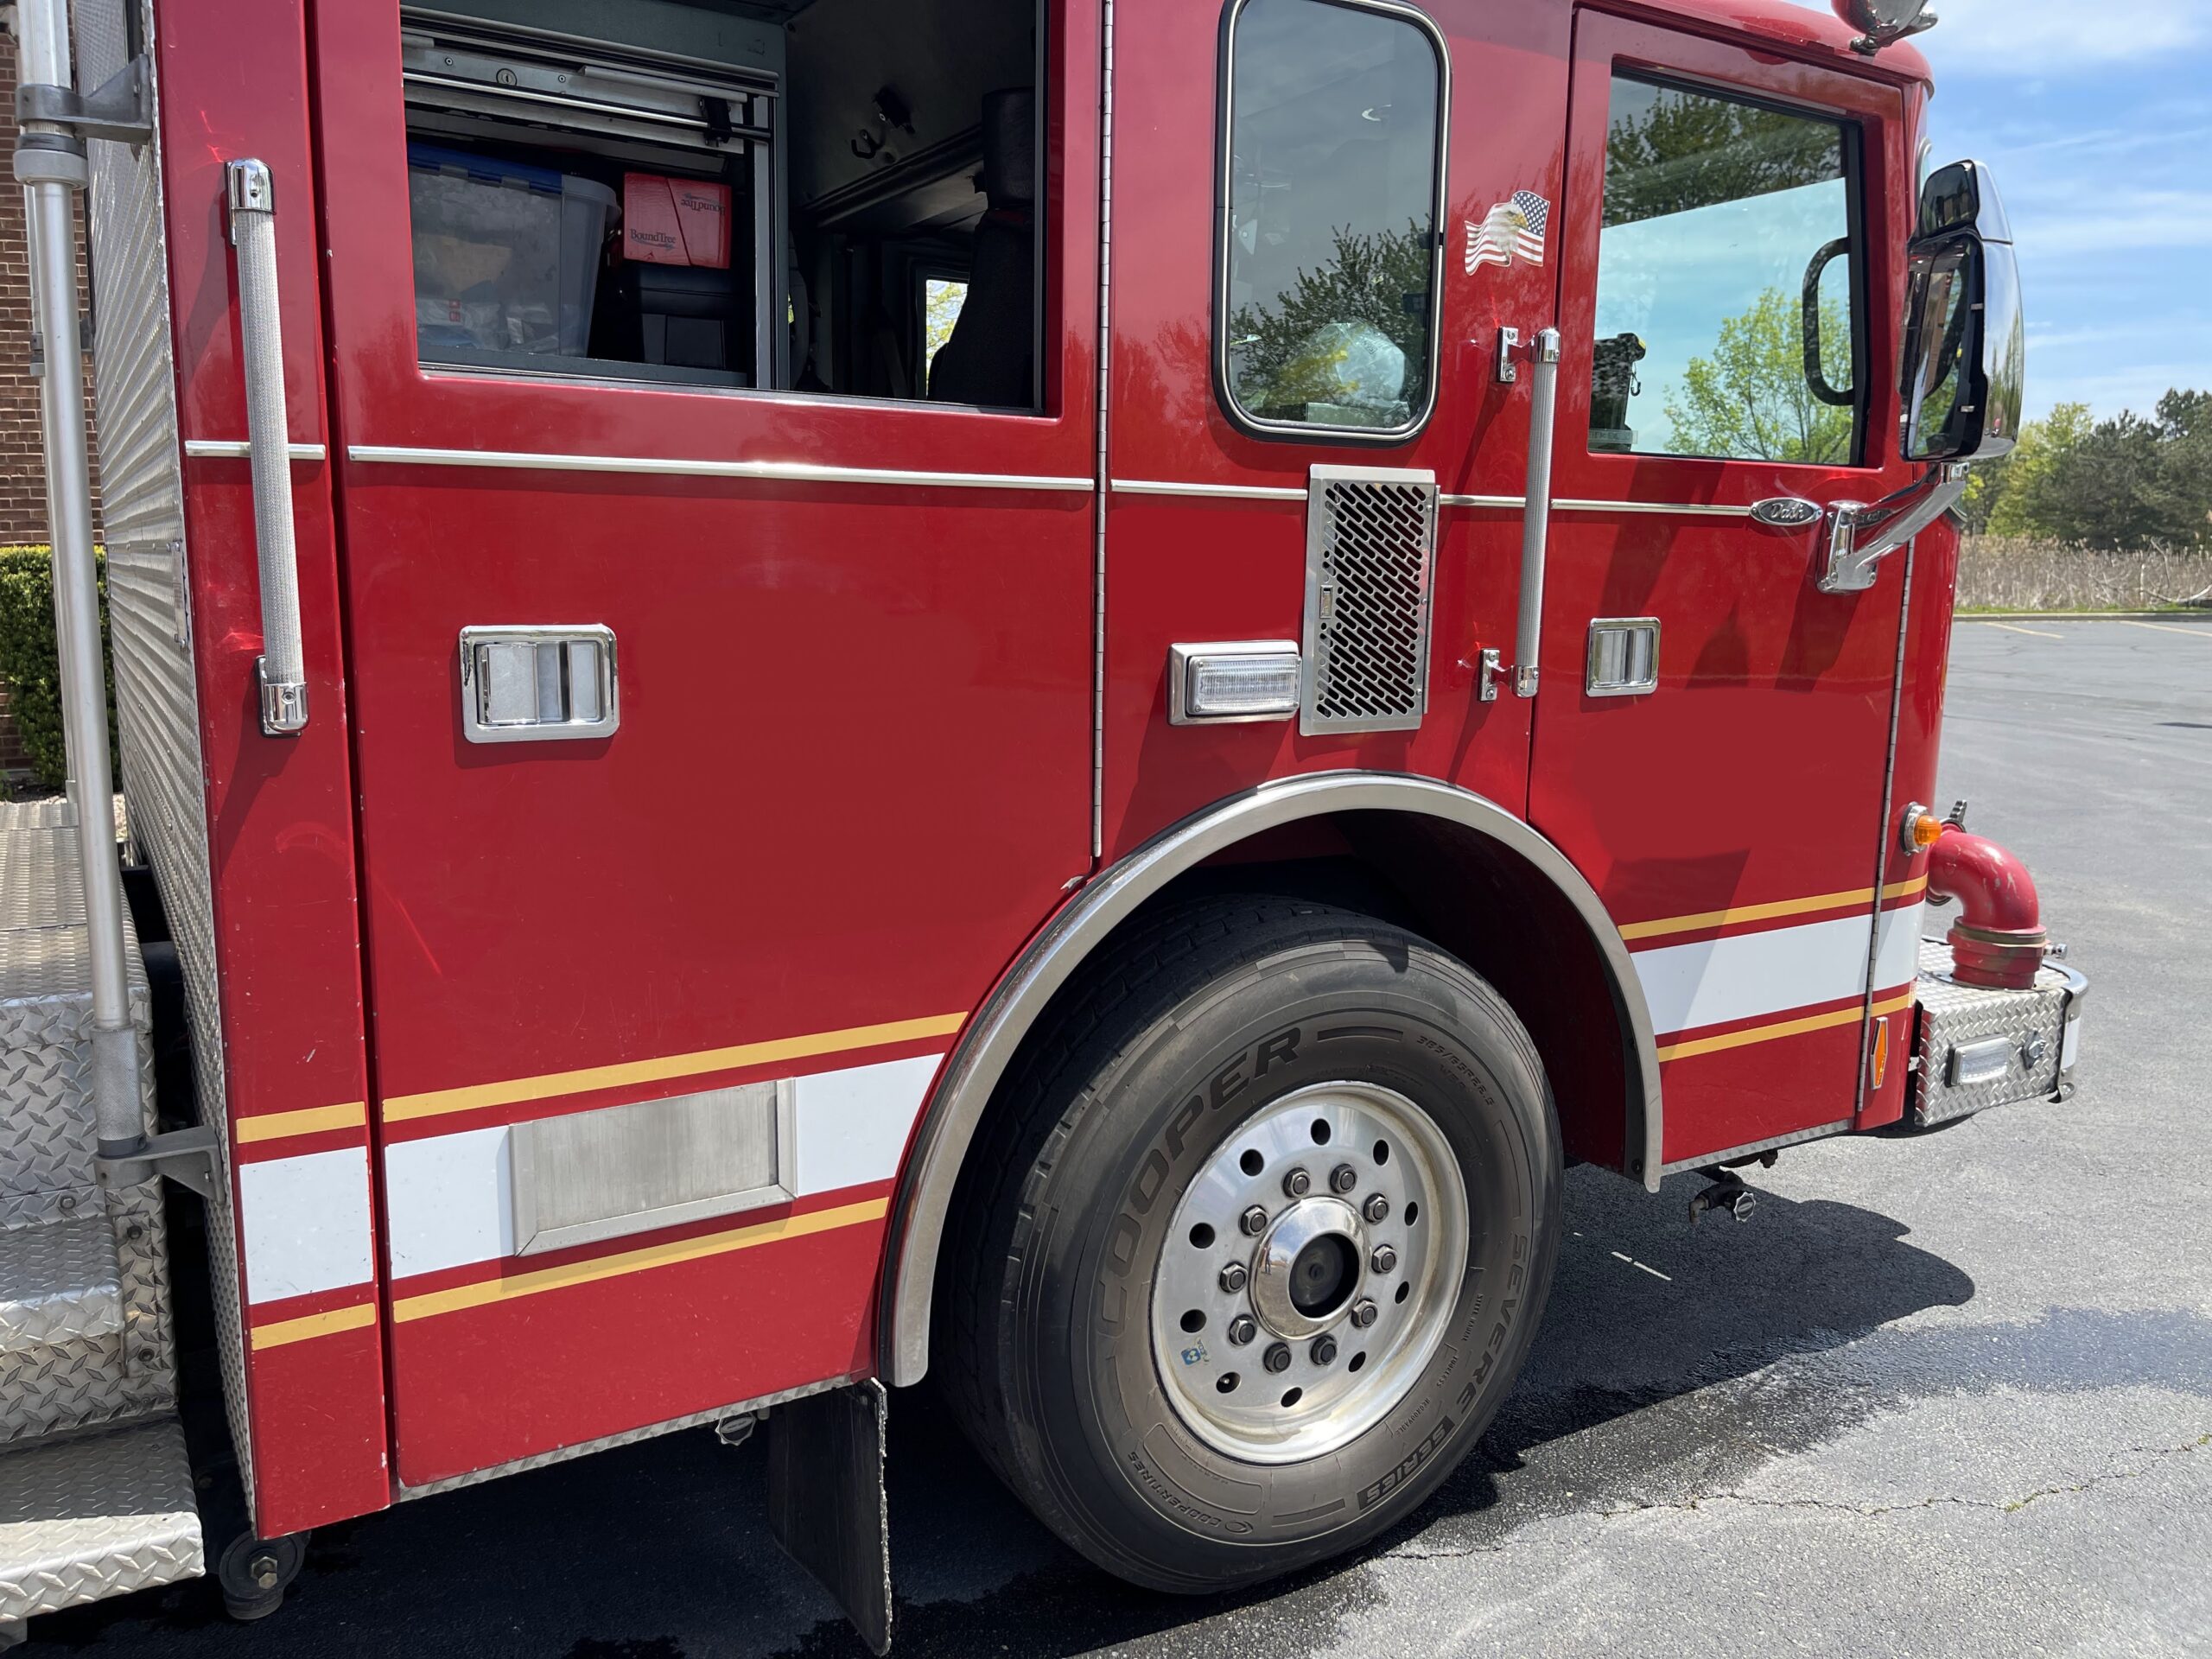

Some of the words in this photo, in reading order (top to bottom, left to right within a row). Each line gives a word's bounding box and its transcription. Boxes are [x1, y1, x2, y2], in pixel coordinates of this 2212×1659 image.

[631, 229, 676, 244] BoundTree
[1770, 501, 1806, 520] Dash
[1098, 1027, 1301, 1337] COOPER
[1456, 1233, 1529, 1415] SEVERE
[1366, 1427, 1448, 1505] SERIES
